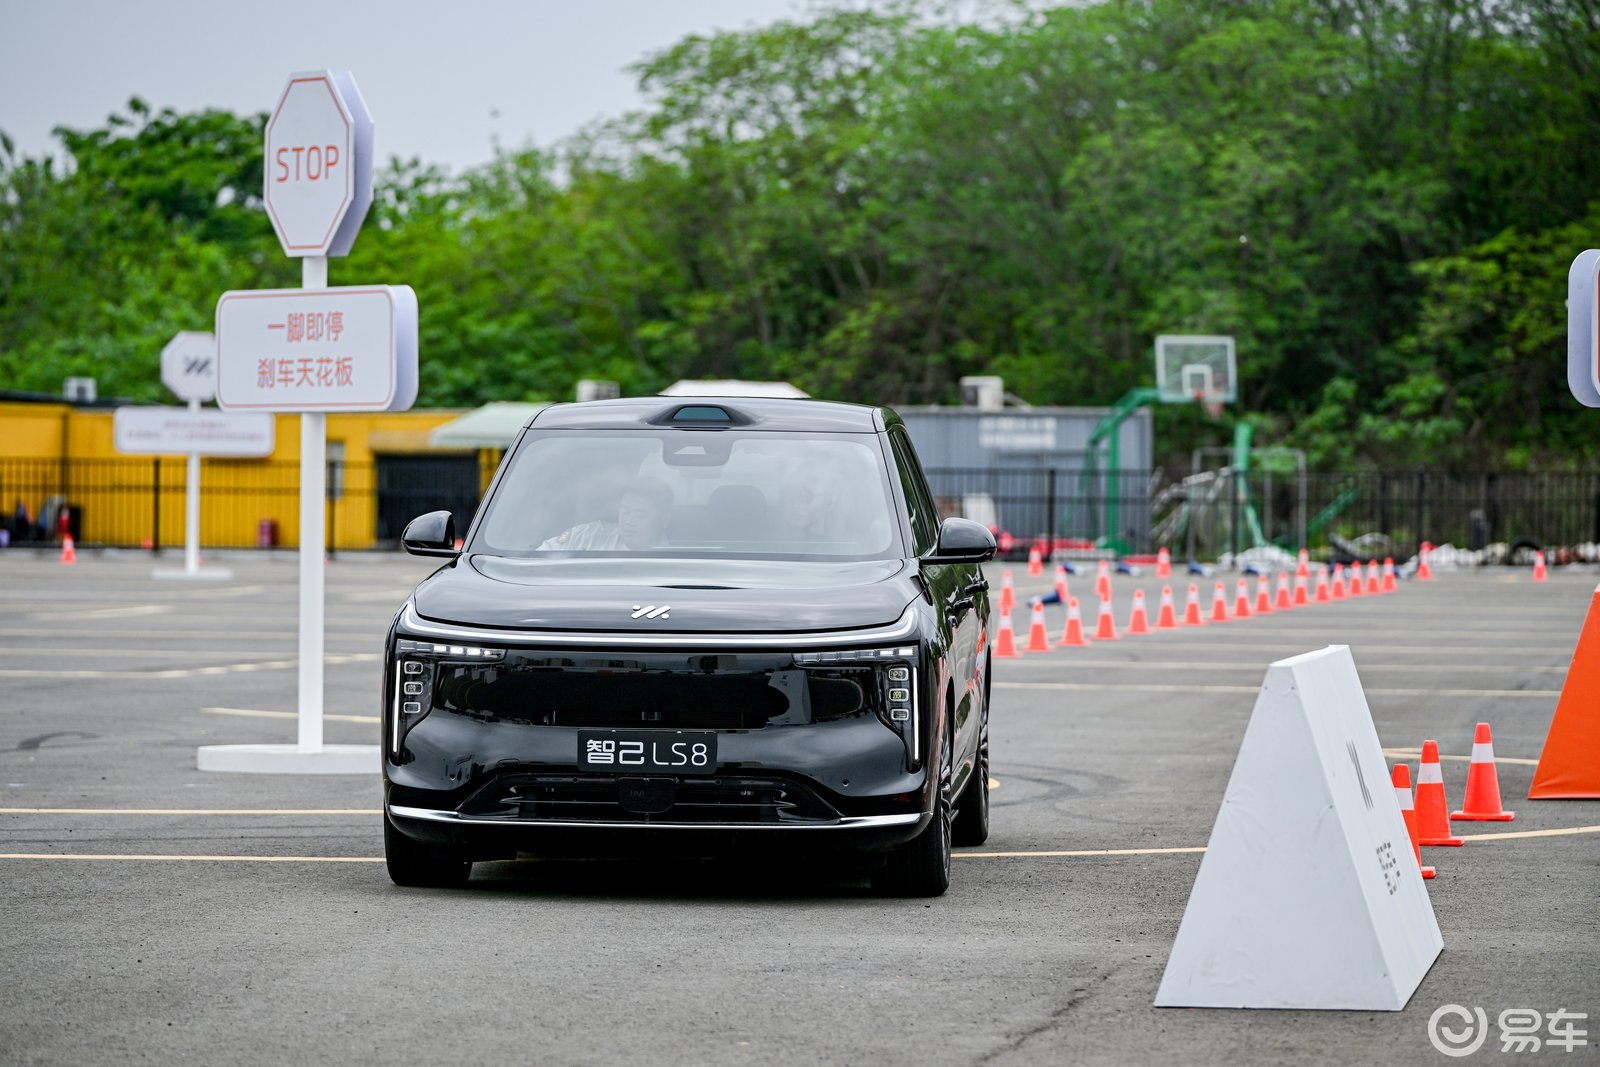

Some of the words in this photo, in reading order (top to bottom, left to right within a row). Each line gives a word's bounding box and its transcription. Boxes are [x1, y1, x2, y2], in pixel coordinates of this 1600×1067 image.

[276, 144, 340, 183] STOP
[267, 310, 344, 343] 一脚即停
[257, 356, 353, 388] 刹车天花板
